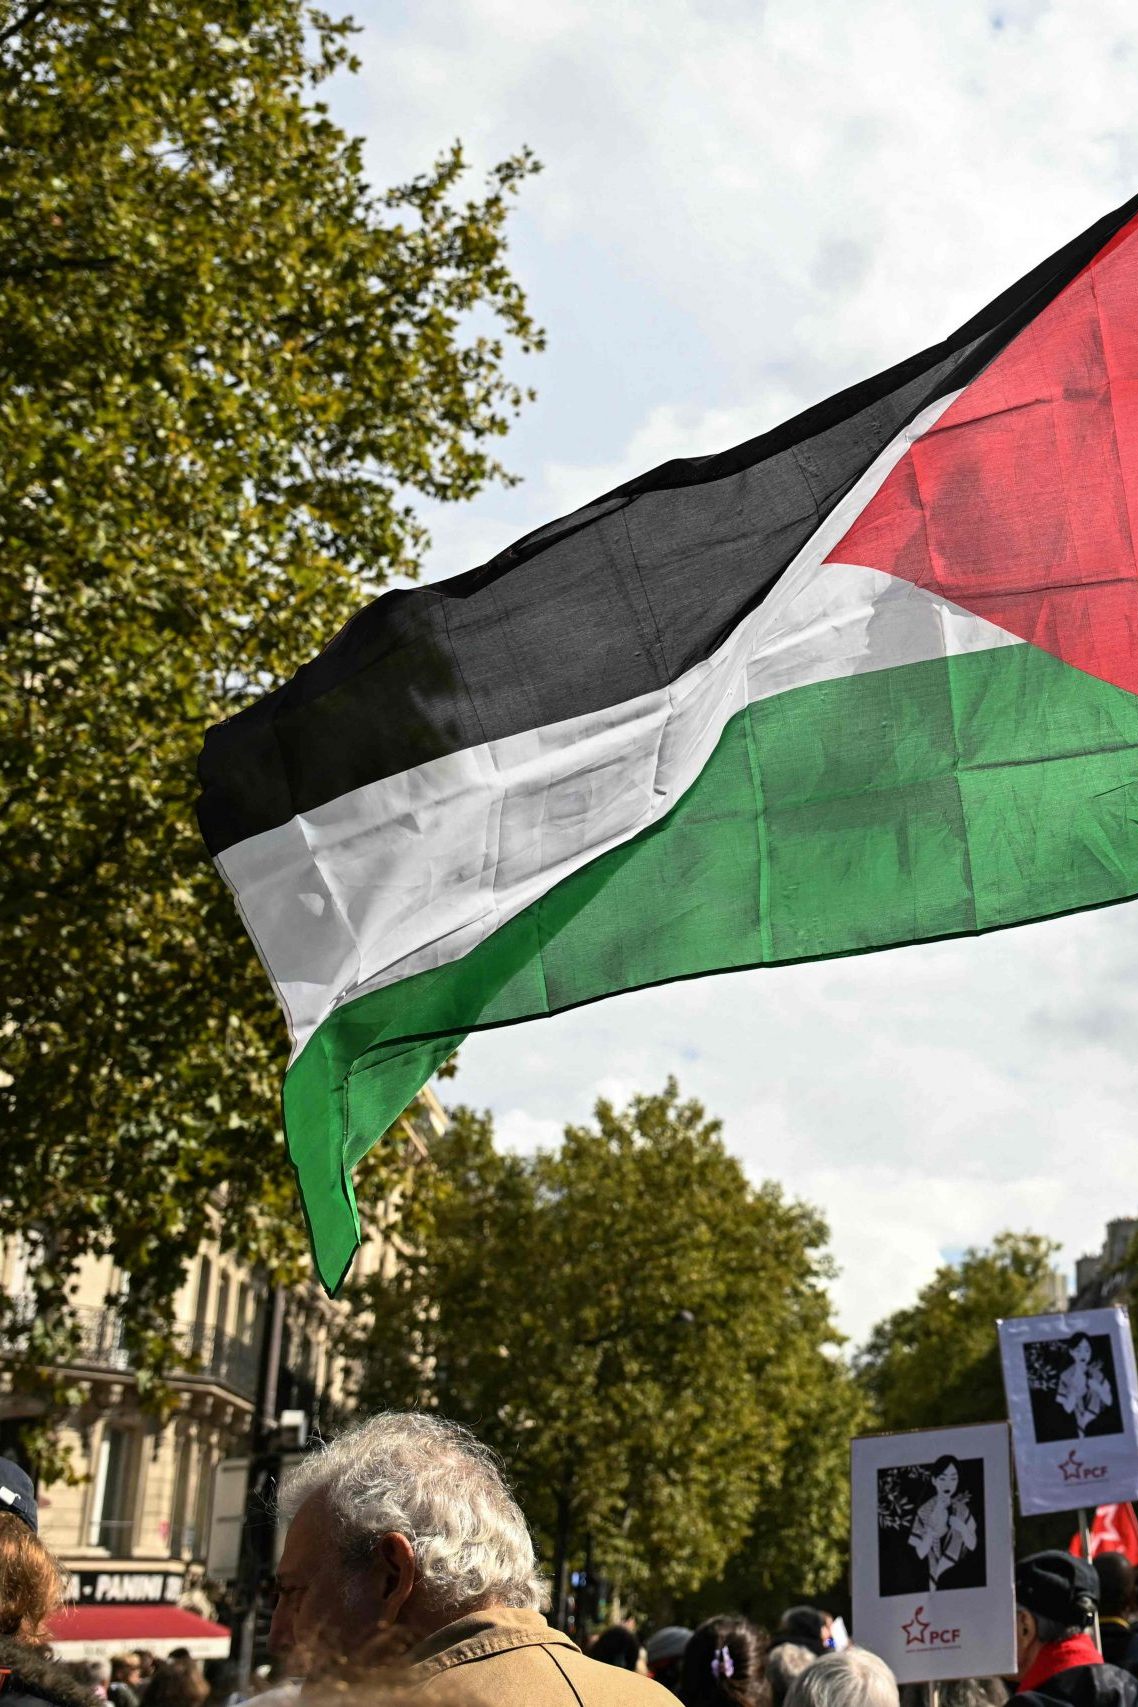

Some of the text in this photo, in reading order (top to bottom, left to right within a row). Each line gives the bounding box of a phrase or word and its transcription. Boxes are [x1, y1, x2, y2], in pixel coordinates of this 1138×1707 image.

[1083, 1466, 1108, 1479] PCF
[95, 1574, 164, 1601] PANINI
[929, 1628, 960, 1645] PCF
